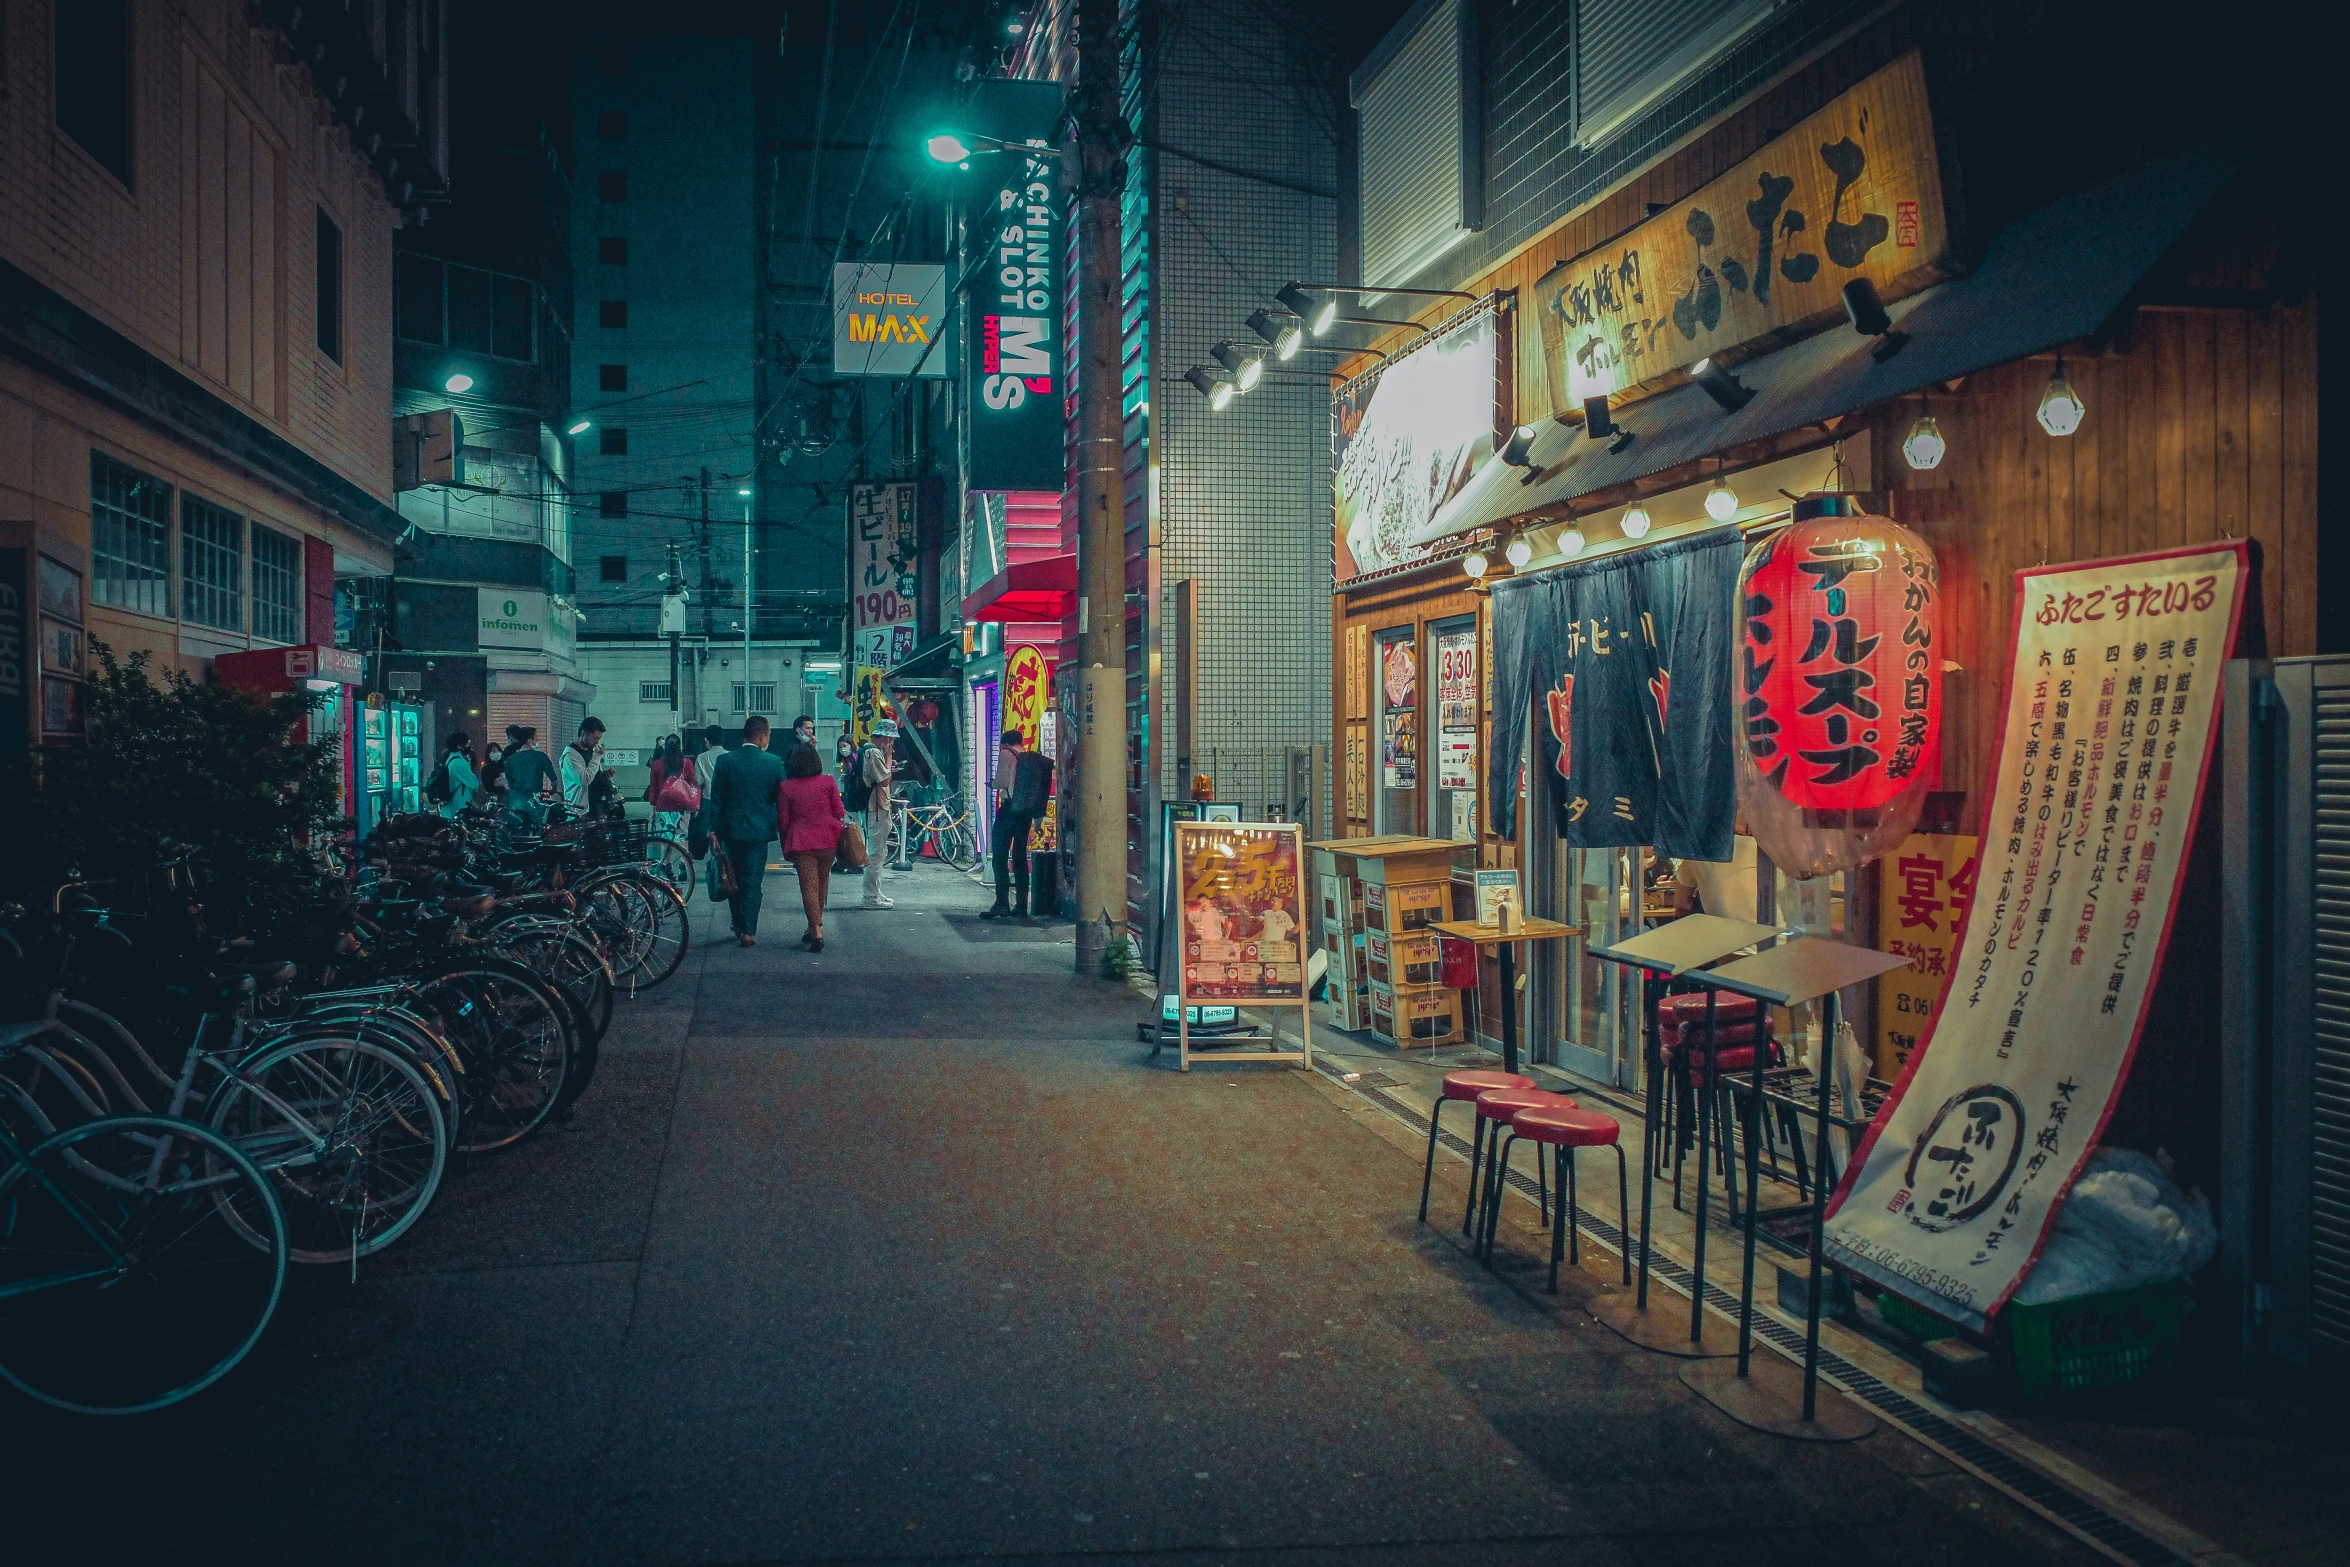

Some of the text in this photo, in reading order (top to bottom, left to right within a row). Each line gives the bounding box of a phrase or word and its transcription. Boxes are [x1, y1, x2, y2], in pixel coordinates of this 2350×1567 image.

[1000, 190, 1023, 309] & SLOT
[1026, 138, 1050, 310] PACHINKO
[859, 292, 919, 306] HOTEL
[1550, 248, 1642, 328] 大阪焼肉
[984, 315, 1000, 374] HYPER
[1577, 315, 1666, 378] ホルモン
[855, 489, 888, 588] 生ビール
[481, 617, 538, 632] infomen
[855, 590, 912, 627] 190円
[2036, 575, 2218, 627] ふたごすたいる
[1798, 545, 1883, 785] テールスープ
[1883, 547, 1933, 780] おかんの自家製
